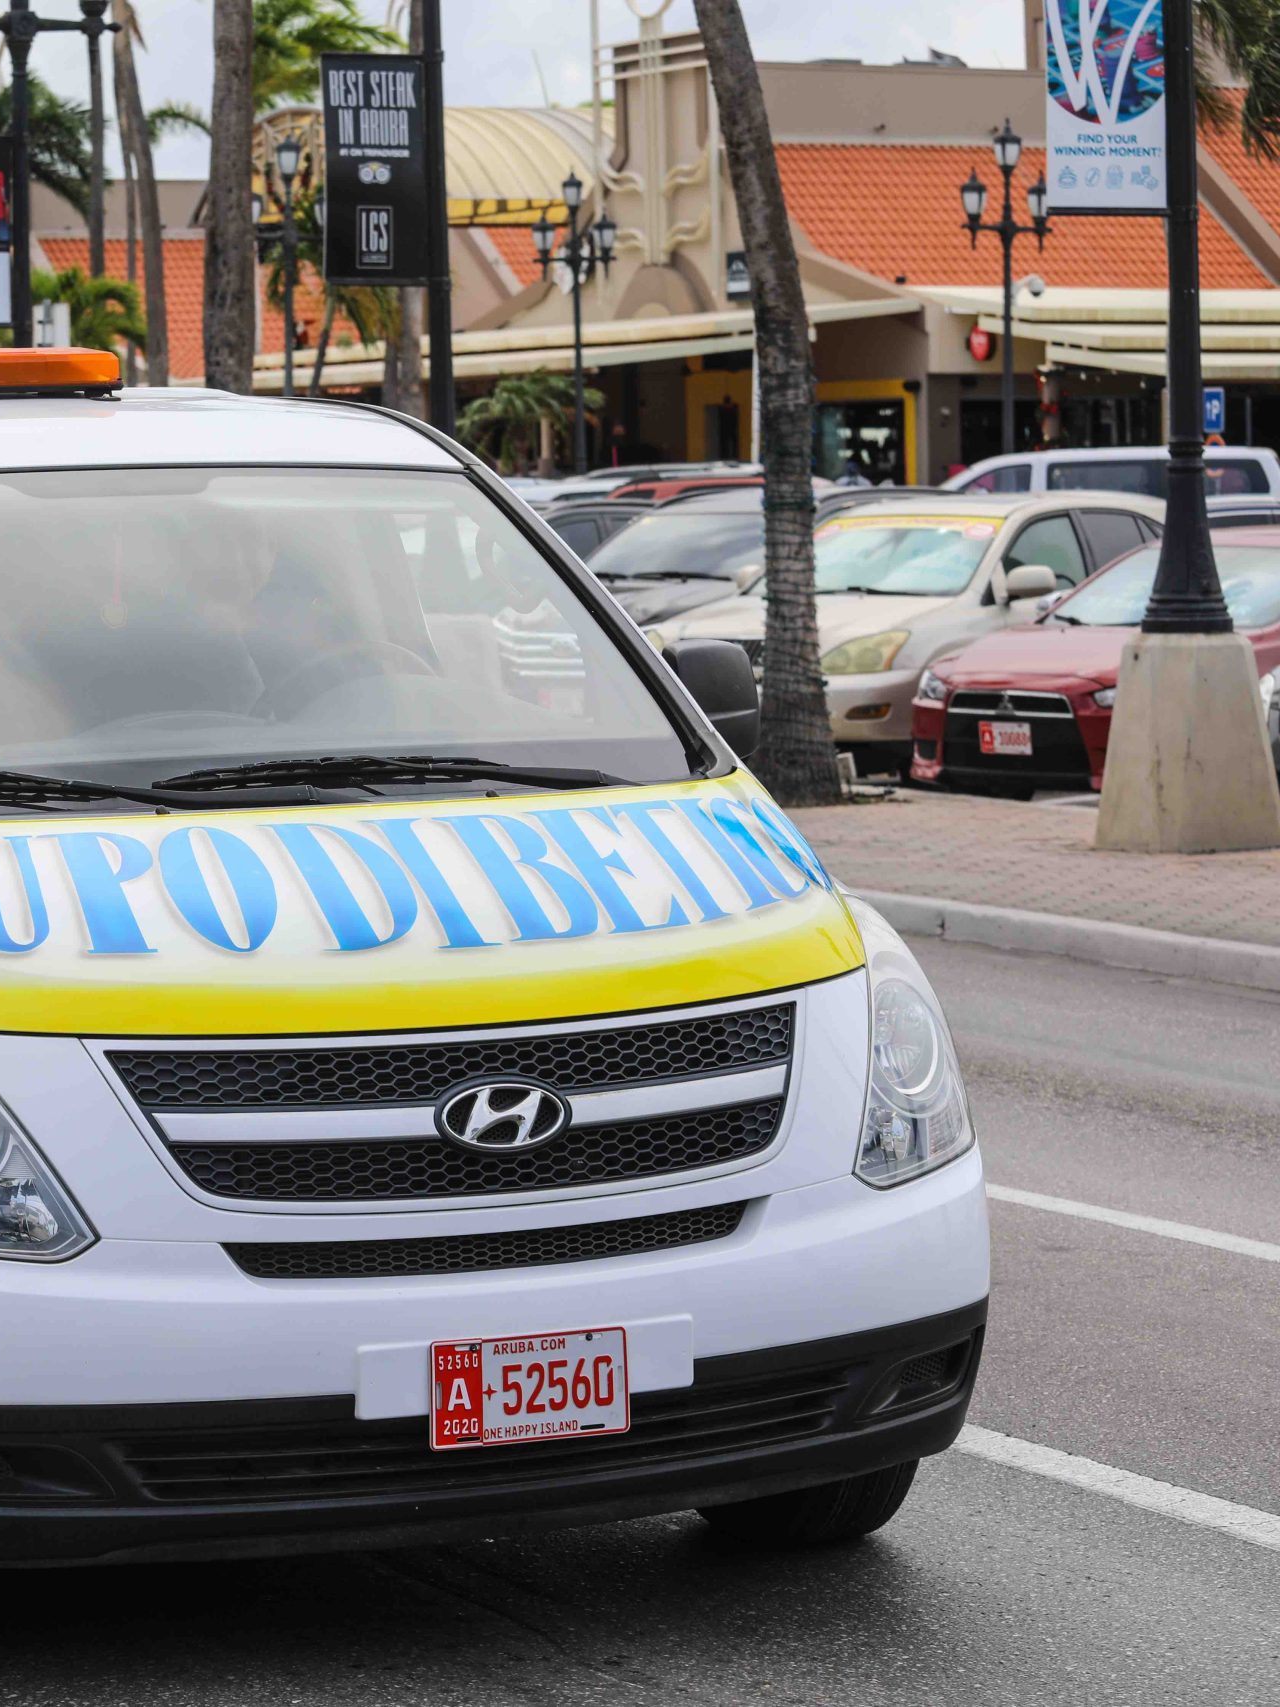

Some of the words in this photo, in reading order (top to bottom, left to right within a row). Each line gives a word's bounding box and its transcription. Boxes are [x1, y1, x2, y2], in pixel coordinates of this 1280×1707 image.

[328, 70, 364, 107] BEST
[370, 71, 417, 108] STEAK
[338, 109, 354, 145] IN
[360, 109, 409, 146] ARUBA
[1077, 133, 1104, 144] FIND
[1106, 134, 1138, 145] YOUR
[1054, 146, 1106, 157] WINNING
[361, 211, 389, 252] LGS
[493, 1338, 566, 1355] ARUBA.COM
[438, 1353, 479, 1371] 52560
[447, 1378, 472, 1412] A
[502, 1355, 614, 1416] 52560
[443, 1418, 479, 1436] 2020
[483, 1427, 503, 1440] ONE
[504, 1423, 538, 1438] HAPPY
[540, 1420, 578, 1434] ISLAND
